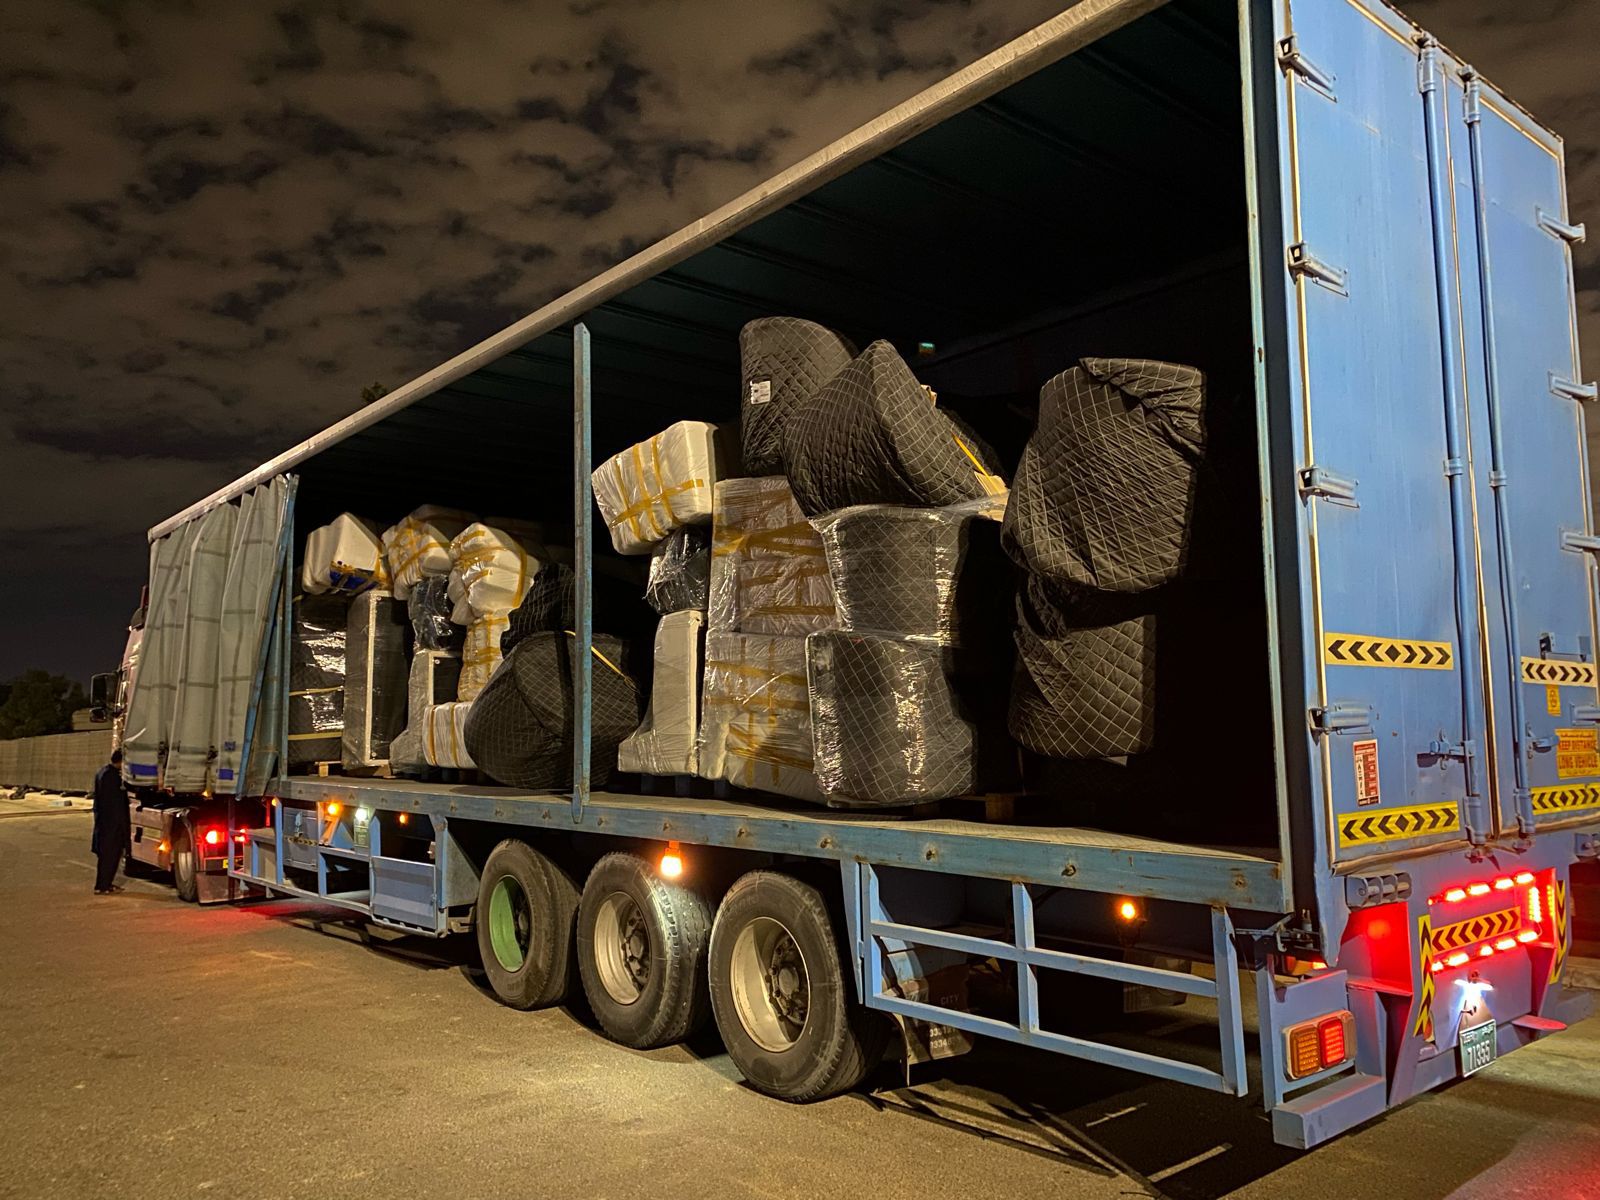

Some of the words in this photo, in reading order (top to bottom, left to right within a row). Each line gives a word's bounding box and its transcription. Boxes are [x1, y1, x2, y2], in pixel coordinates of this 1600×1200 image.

[1559, 755, 1573, 769] LONG
[1575, 755, 1598, 768] VEHICLE
[1467, 1039, 1490, 1070] 71355
